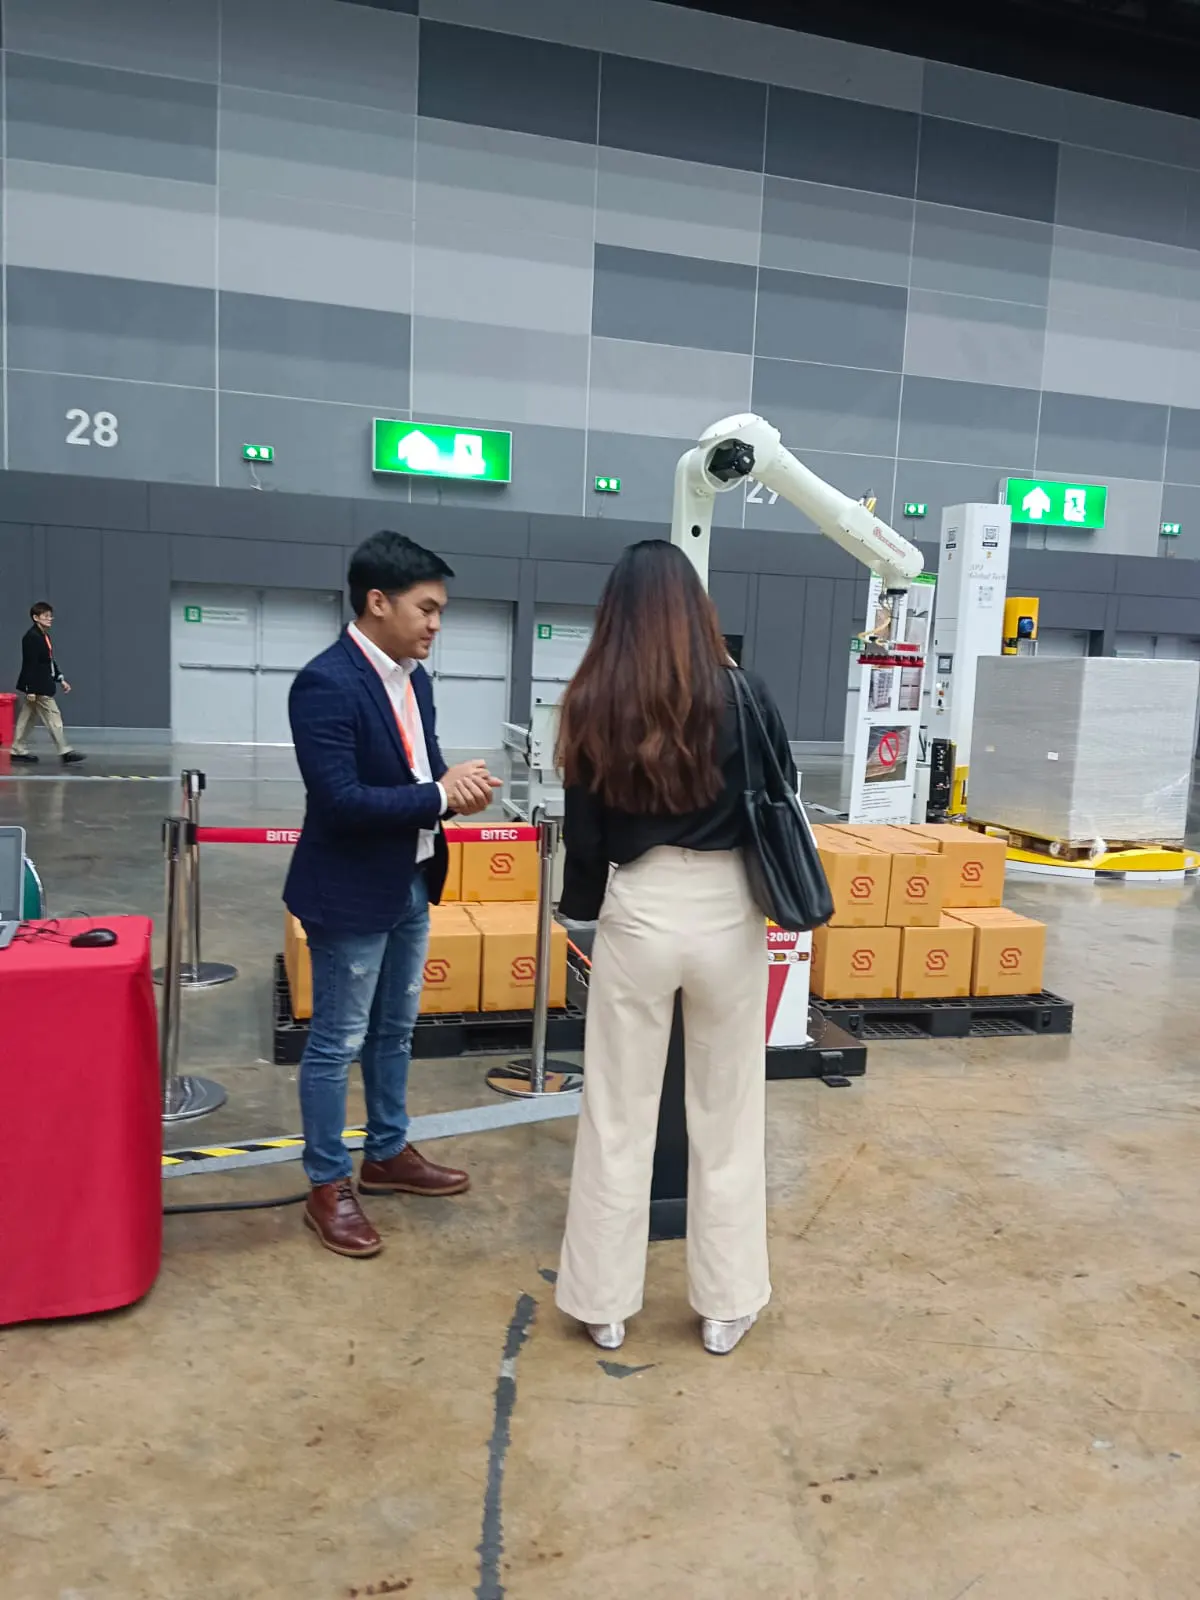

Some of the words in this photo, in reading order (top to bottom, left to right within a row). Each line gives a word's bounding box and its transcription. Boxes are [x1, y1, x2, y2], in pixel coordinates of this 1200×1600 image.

[65, 408, 118, 447] 28
[266, 830, 301, 842] BITE
[480, 829, 518, 840] BITEC
